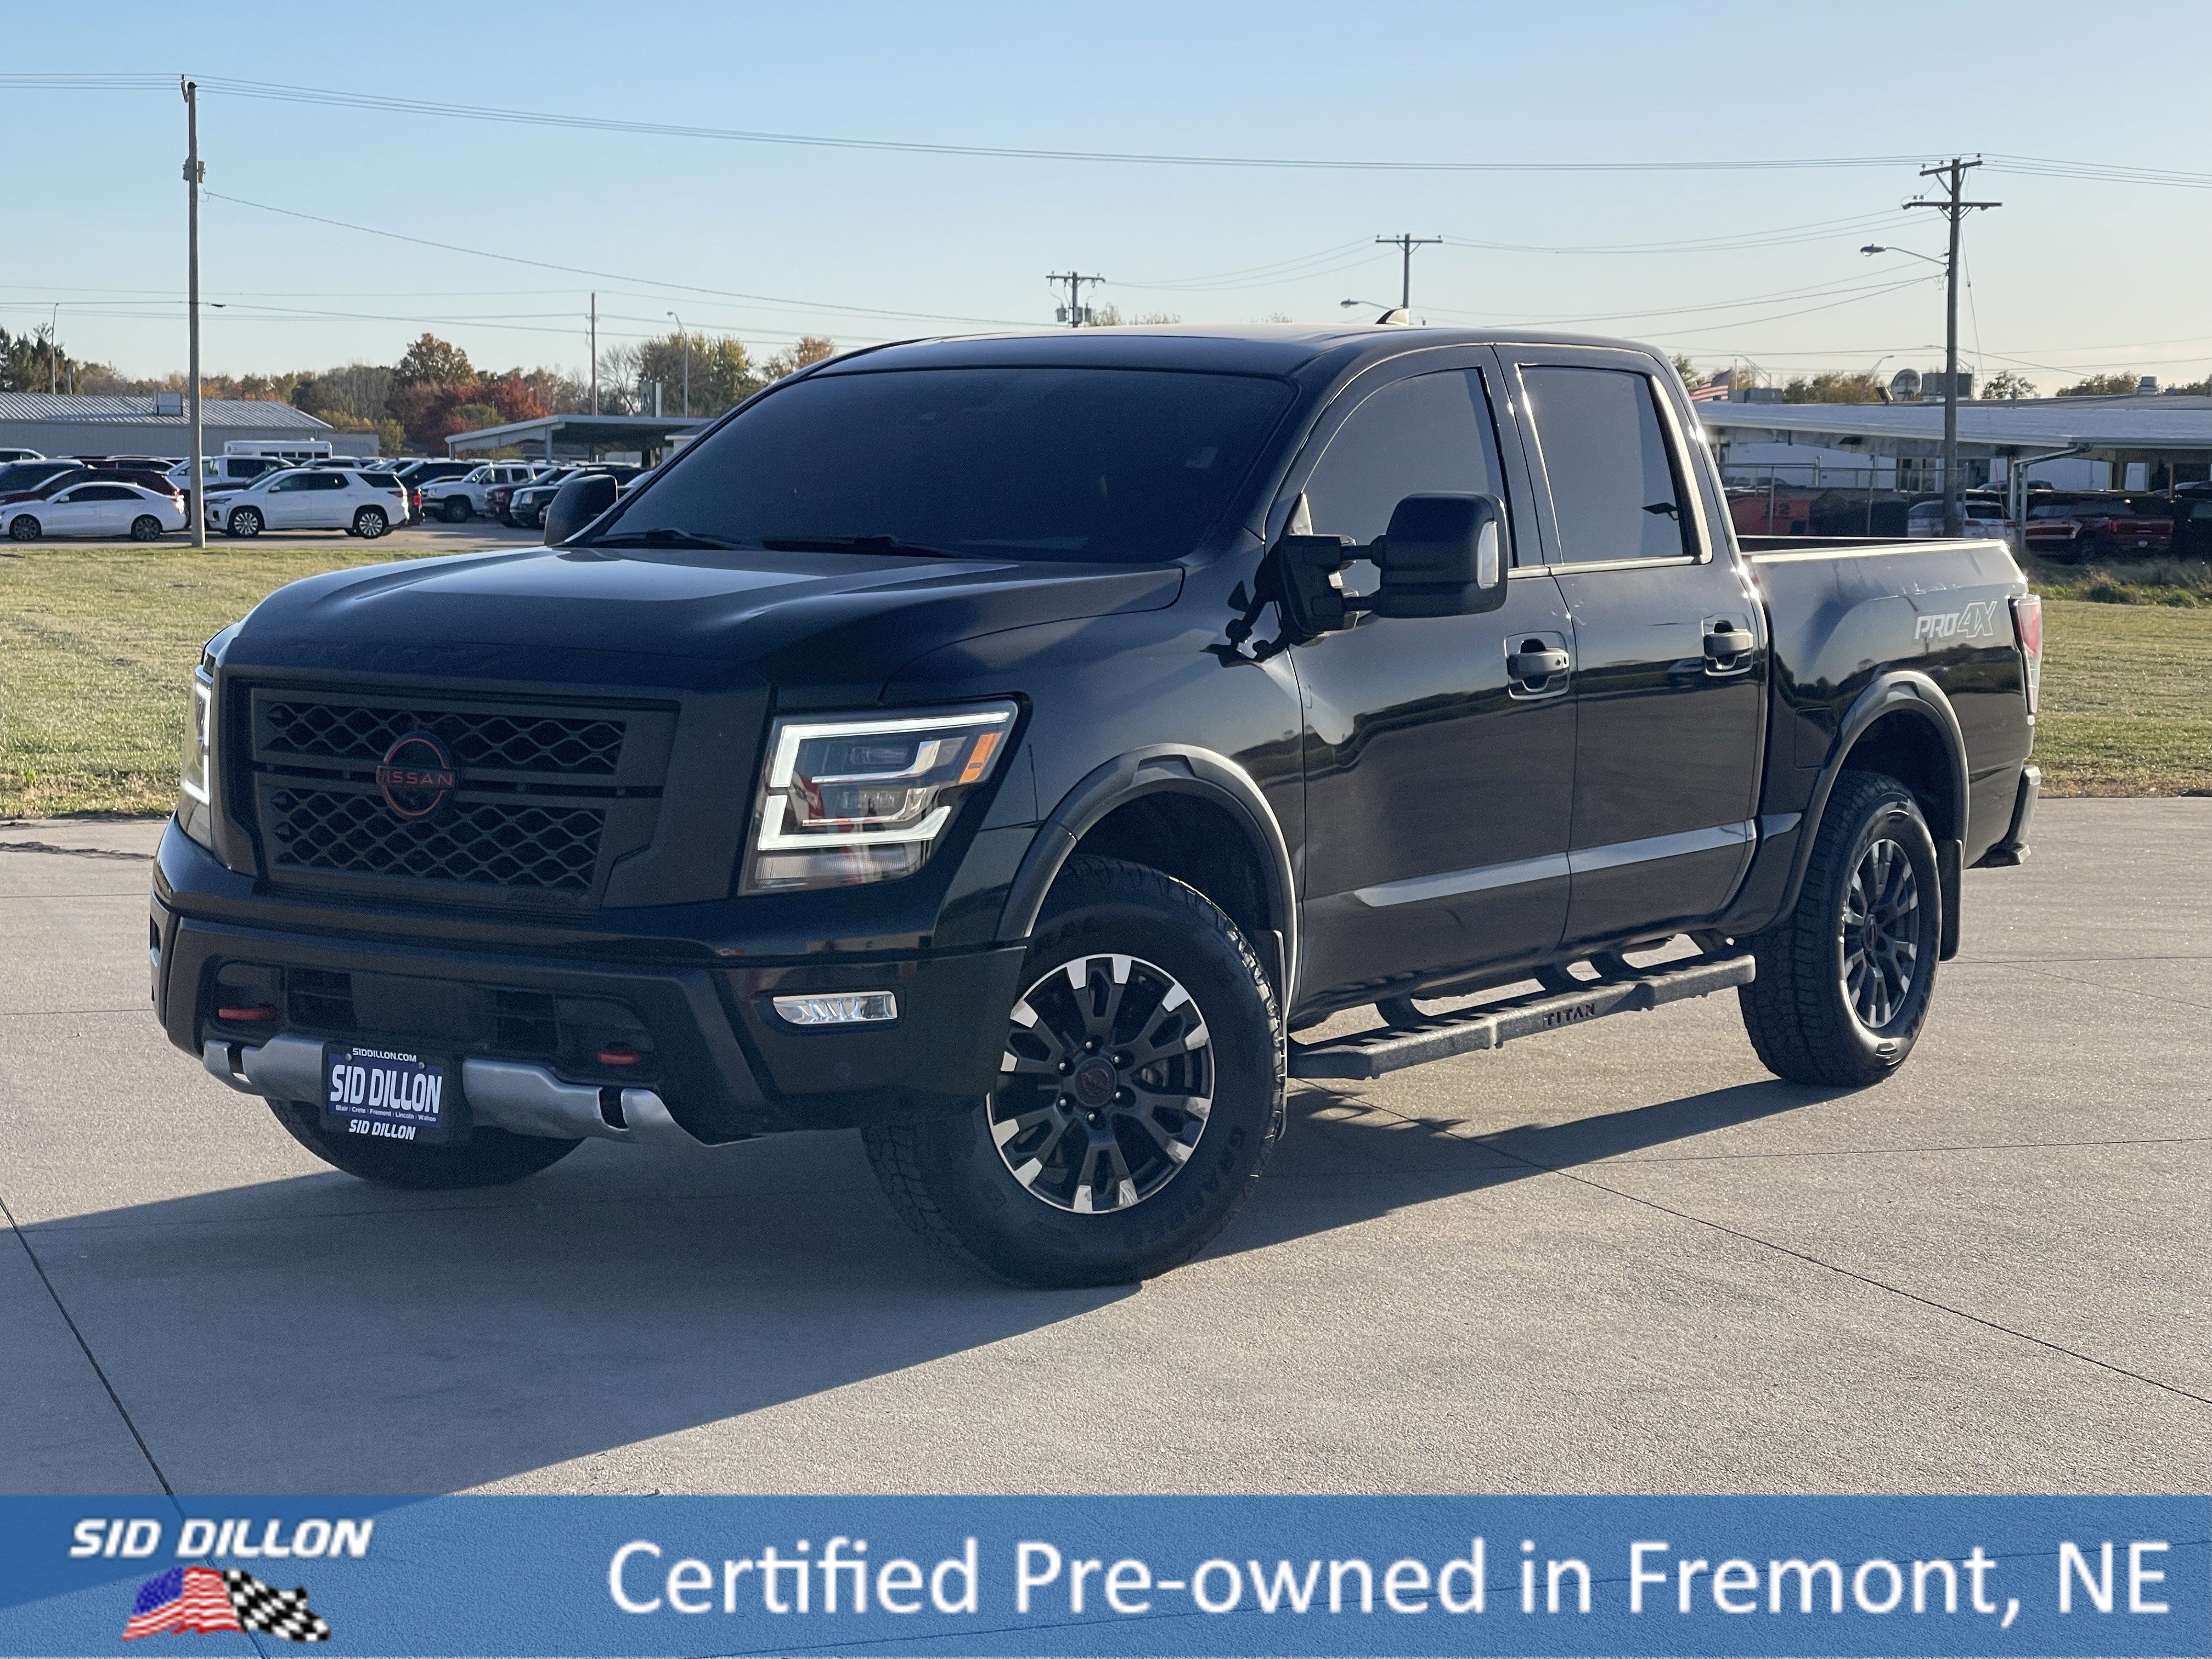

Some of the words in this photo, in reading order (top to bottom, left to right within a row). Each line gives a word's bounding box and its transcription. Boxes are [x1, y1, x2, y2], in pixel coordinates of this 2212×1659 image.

[376, 766, 453, 786] NISSAN
[1543, 1003, 1595, 1026] TITAN
[352, 1048, 417, 1062] SIDDILLON.COM
[330, 1064, 366, 1104] SID
[369, 1068, 442, 1114] DILLON
[370, 1108, 391, 1117] Fremont
[349, 1119, 370, 1134] SID
[371, 1121, 416, 1140] DILLON
